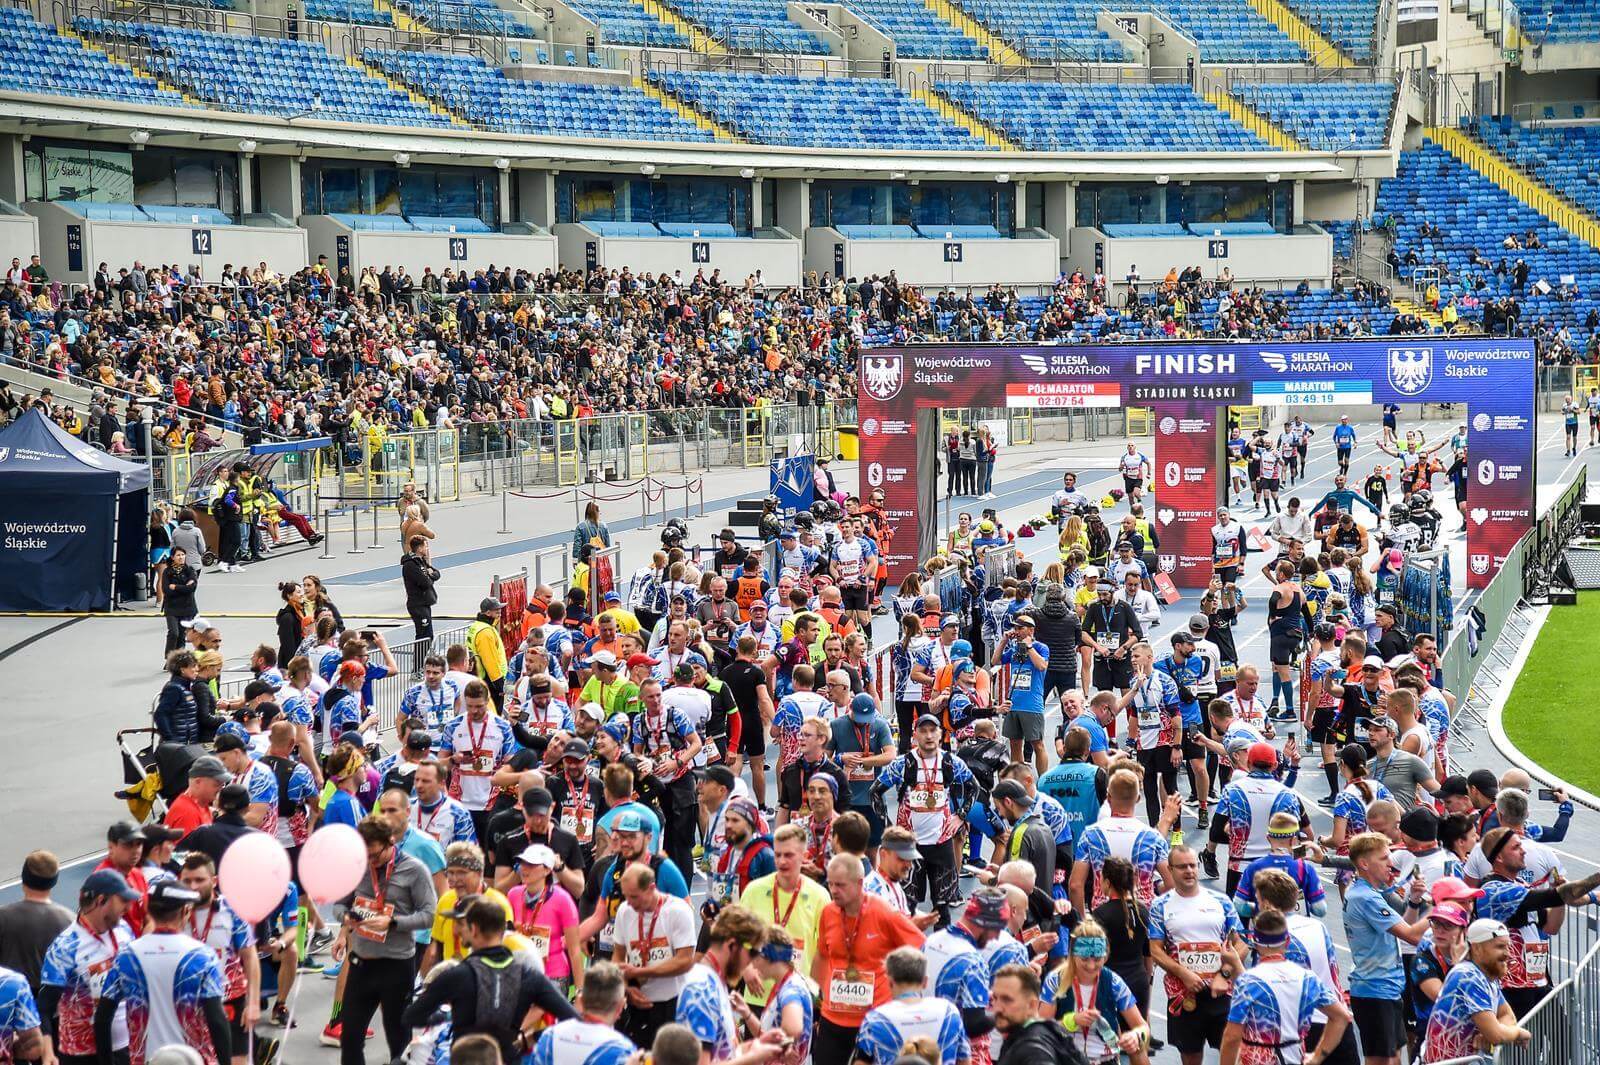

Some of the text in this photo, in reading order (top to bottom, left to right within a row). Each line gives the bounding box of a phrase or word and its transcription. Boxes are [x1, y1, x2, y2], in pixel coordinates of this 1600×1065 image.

[195, 233, 208, 251] 12
[452, 241, 464, 257] 13
[695, 244, 706, 260] 14
[947, 246, 959, 260] 15
[1212, 243, 1225, 256] 16
[1051, 355, 1088, 365] SILESIA
[1291, 352, 1330, 362] SILESIA
[1445, 349, 1530, 362] Województwo
[914, 357, 991, 371] Województwo
[1051, 365, 1110, 375] MARATHON
[1135, 354, 1236, 374] FINISH
[1291, 362, 1353, 372] MARATHON
[914, 370, 954, 385] Śląskie
[1445, 364, 1489, 379] Śląskie
[1027, 383, 1095, 394] PÓŁMARATON
[1136, 385, 1235, 399] STADION ŚLĄSKI
[1284, 381, 1335, 391] MARATON
[1038, 396, 1084, 406] 02:07:54
[286, 454, 295, 462] 14
[1371, 481, 1382, 492] 43
[4, 521, 86, 535] Województwo
[5, 536, 47, 551] Śląskie
[743, 588, 756, 596] KB
[1045, 773, 1085, 783] SECURITY
[916, 791, 939, 801] 628
[1187, 953, 1215, 964] 6787
[836, 984, 866, 996] 6440
